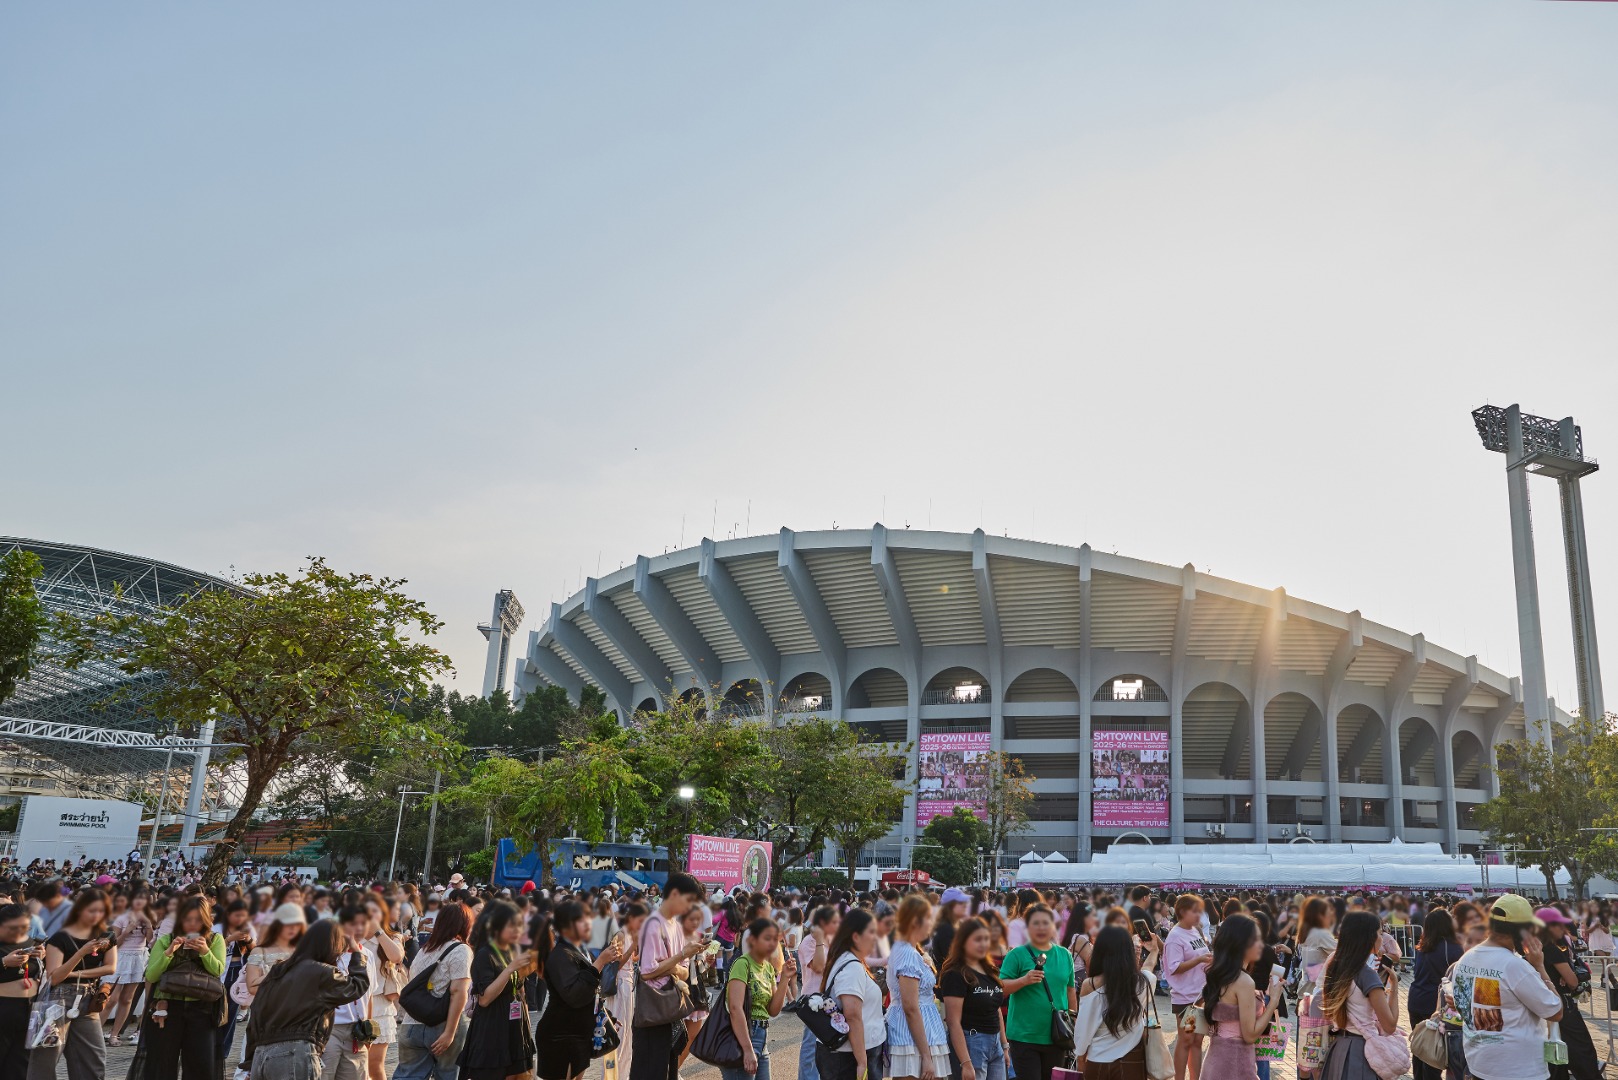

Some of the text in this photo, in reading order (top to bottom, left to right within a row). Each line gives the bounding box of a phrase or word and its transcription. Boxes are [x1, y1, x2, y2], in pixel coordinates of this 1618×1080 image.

[920, 734, 991, 743] SMTOWN LIVE
[1094, 732, 1168, 741] SMTOWN LIVE
[60, 810, 110, 823] สระว่ายน้ำ
[693, 840, 740, 853] SMTOWN LIVE
[692, 852, 715, 862] 2025-26
[1480, 968, 1503, 979] PARK
